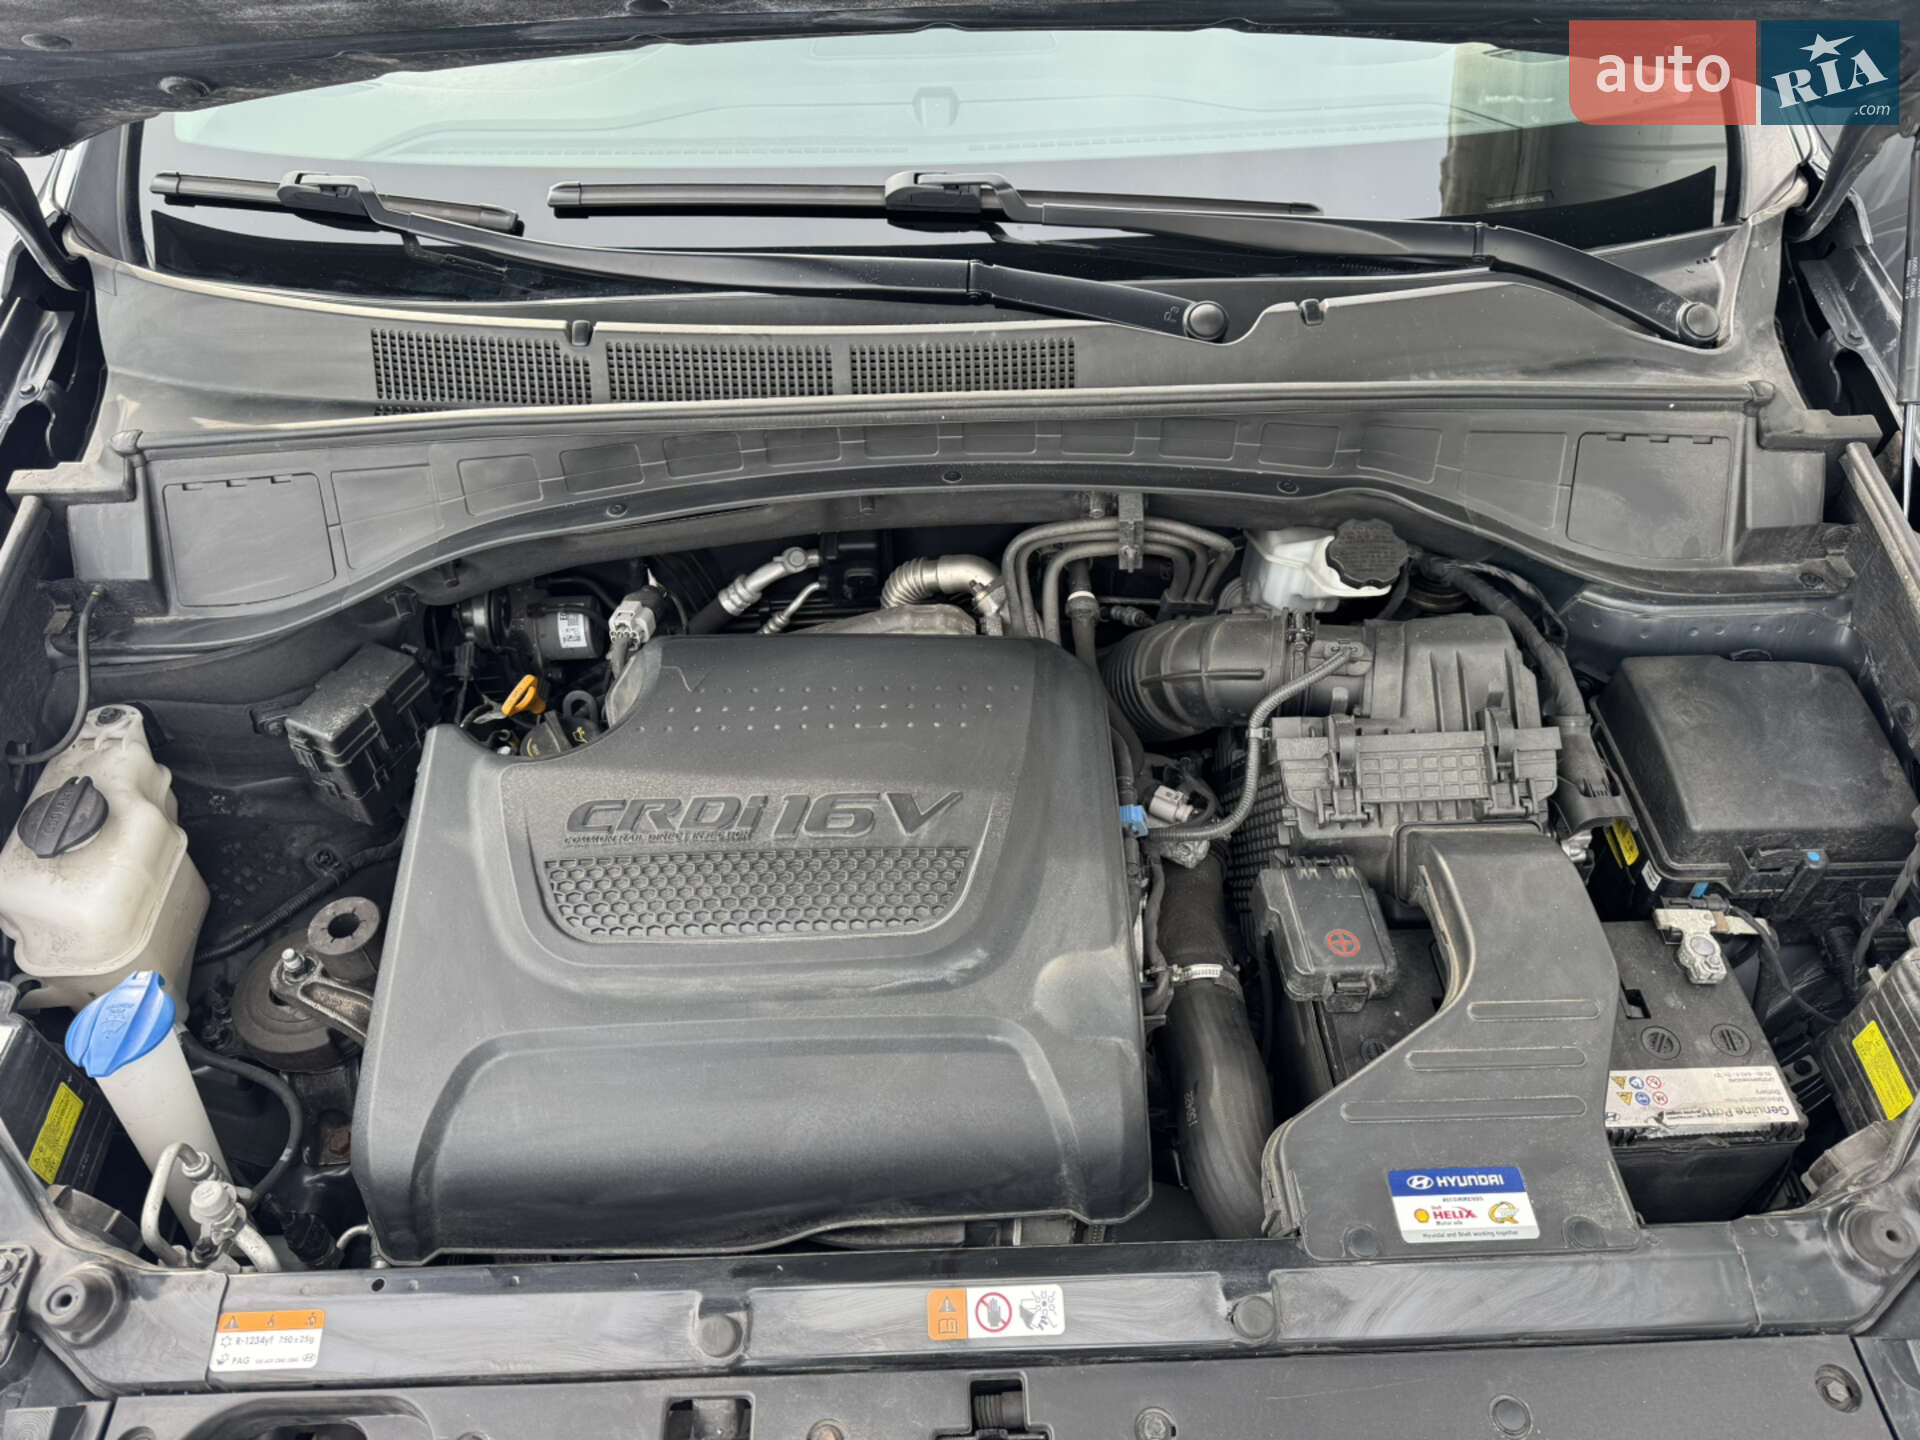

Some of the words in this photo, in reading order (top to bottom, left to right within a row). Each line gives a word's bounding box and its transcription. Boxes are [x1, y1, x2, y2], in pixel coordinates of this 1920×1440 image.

[771, 791, 963, 840] 16V
[1436, 1173, 1504, 1189] HYUNDAI
[1433, 1207, 1477, 1220] HELIX
